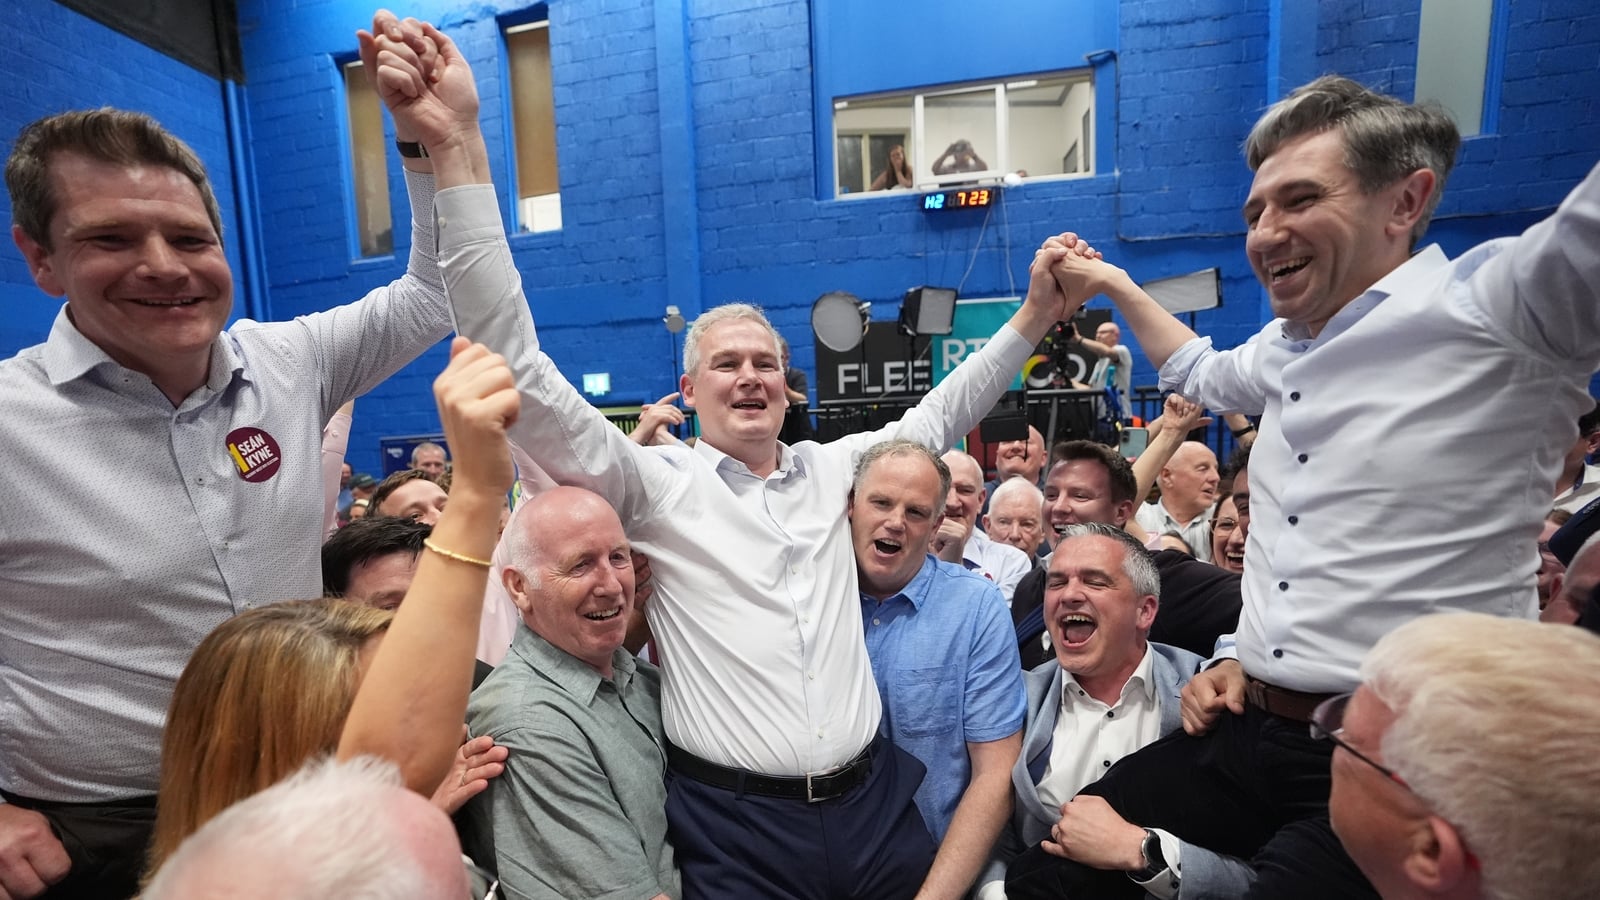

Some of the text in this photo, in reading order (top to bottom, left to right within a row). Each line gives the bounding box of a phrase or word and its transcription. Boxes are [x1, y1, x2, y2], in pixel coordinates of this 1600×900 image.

[942, 338, 991, 371] RT
[237, 433, 266, 456] SEÁN
[245, 445, 274, 468] KYNE
